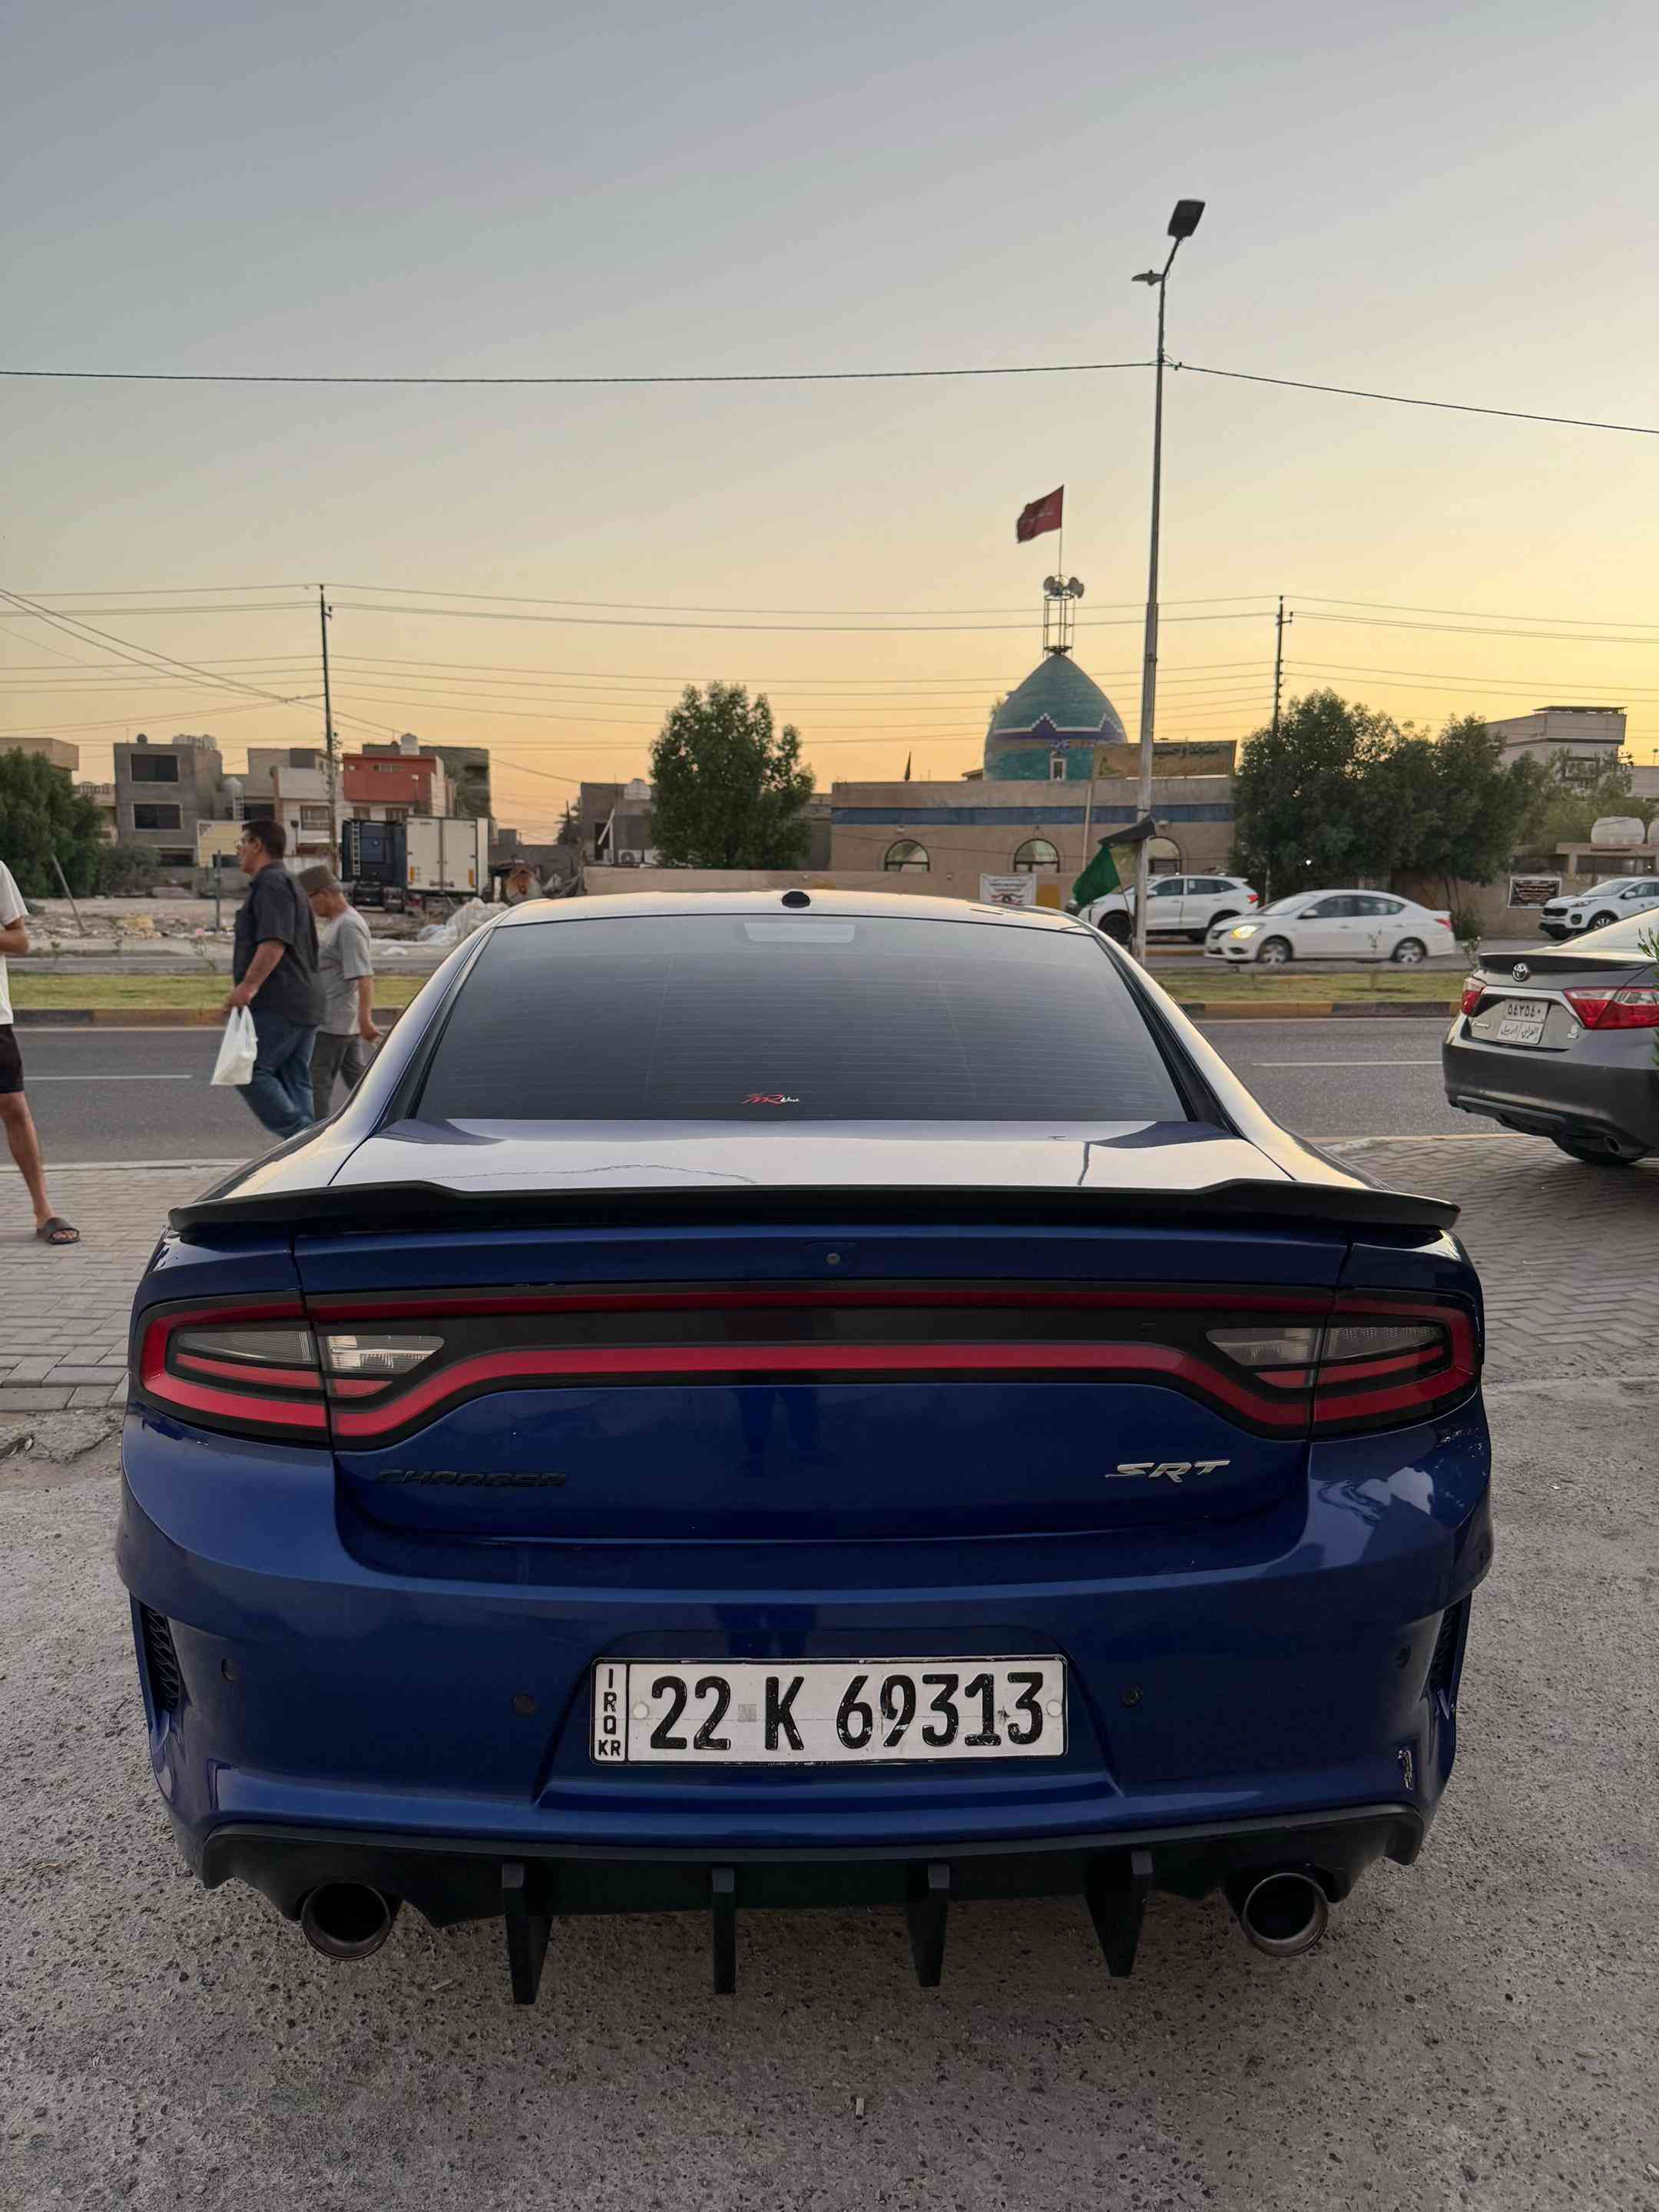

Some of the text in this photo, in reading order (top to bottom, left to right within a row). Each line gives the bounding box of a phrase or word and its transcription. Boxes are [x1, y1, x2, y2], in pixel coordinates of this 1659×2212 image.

[378, 1469, 567, 1487] CHARGER
[1104, 1460, 1230, 1482] SRT
[650, 1671, 1043, 1750] 22 K 69313
[598, 1740, 621, 1757] KR
